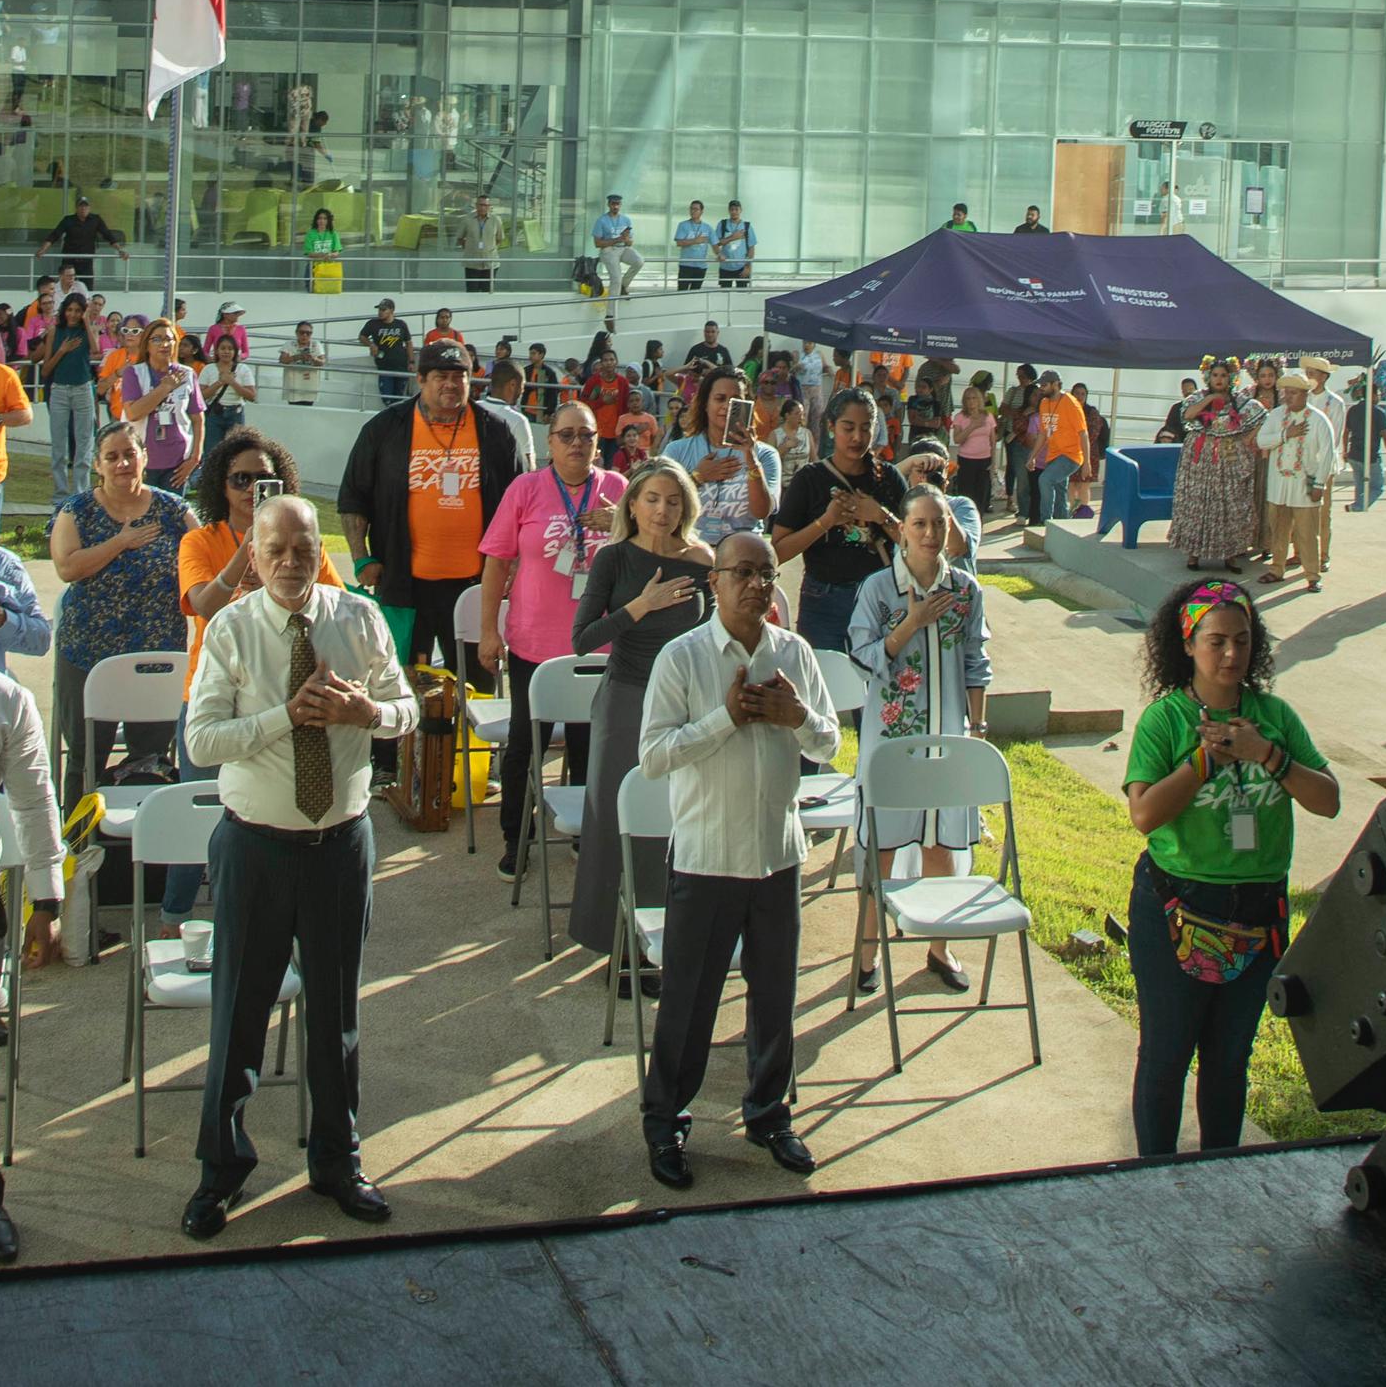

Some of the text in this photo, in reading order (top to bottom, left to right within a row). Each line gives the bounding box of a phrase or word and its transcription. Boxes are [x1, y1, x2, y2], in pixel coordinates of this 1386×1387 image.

[985, 286, 1087, 298] REPÚBLICA DE PANAMÁ
[1106, 284, 1169, 299] MINISTERIO
[1111, 294, 1178, 308] DE CULTURA
[408, 455, 481, 474] EXPRE
[408, 473, 480, 491] SATE
[1193, 780, 1285, 810] SARTE
